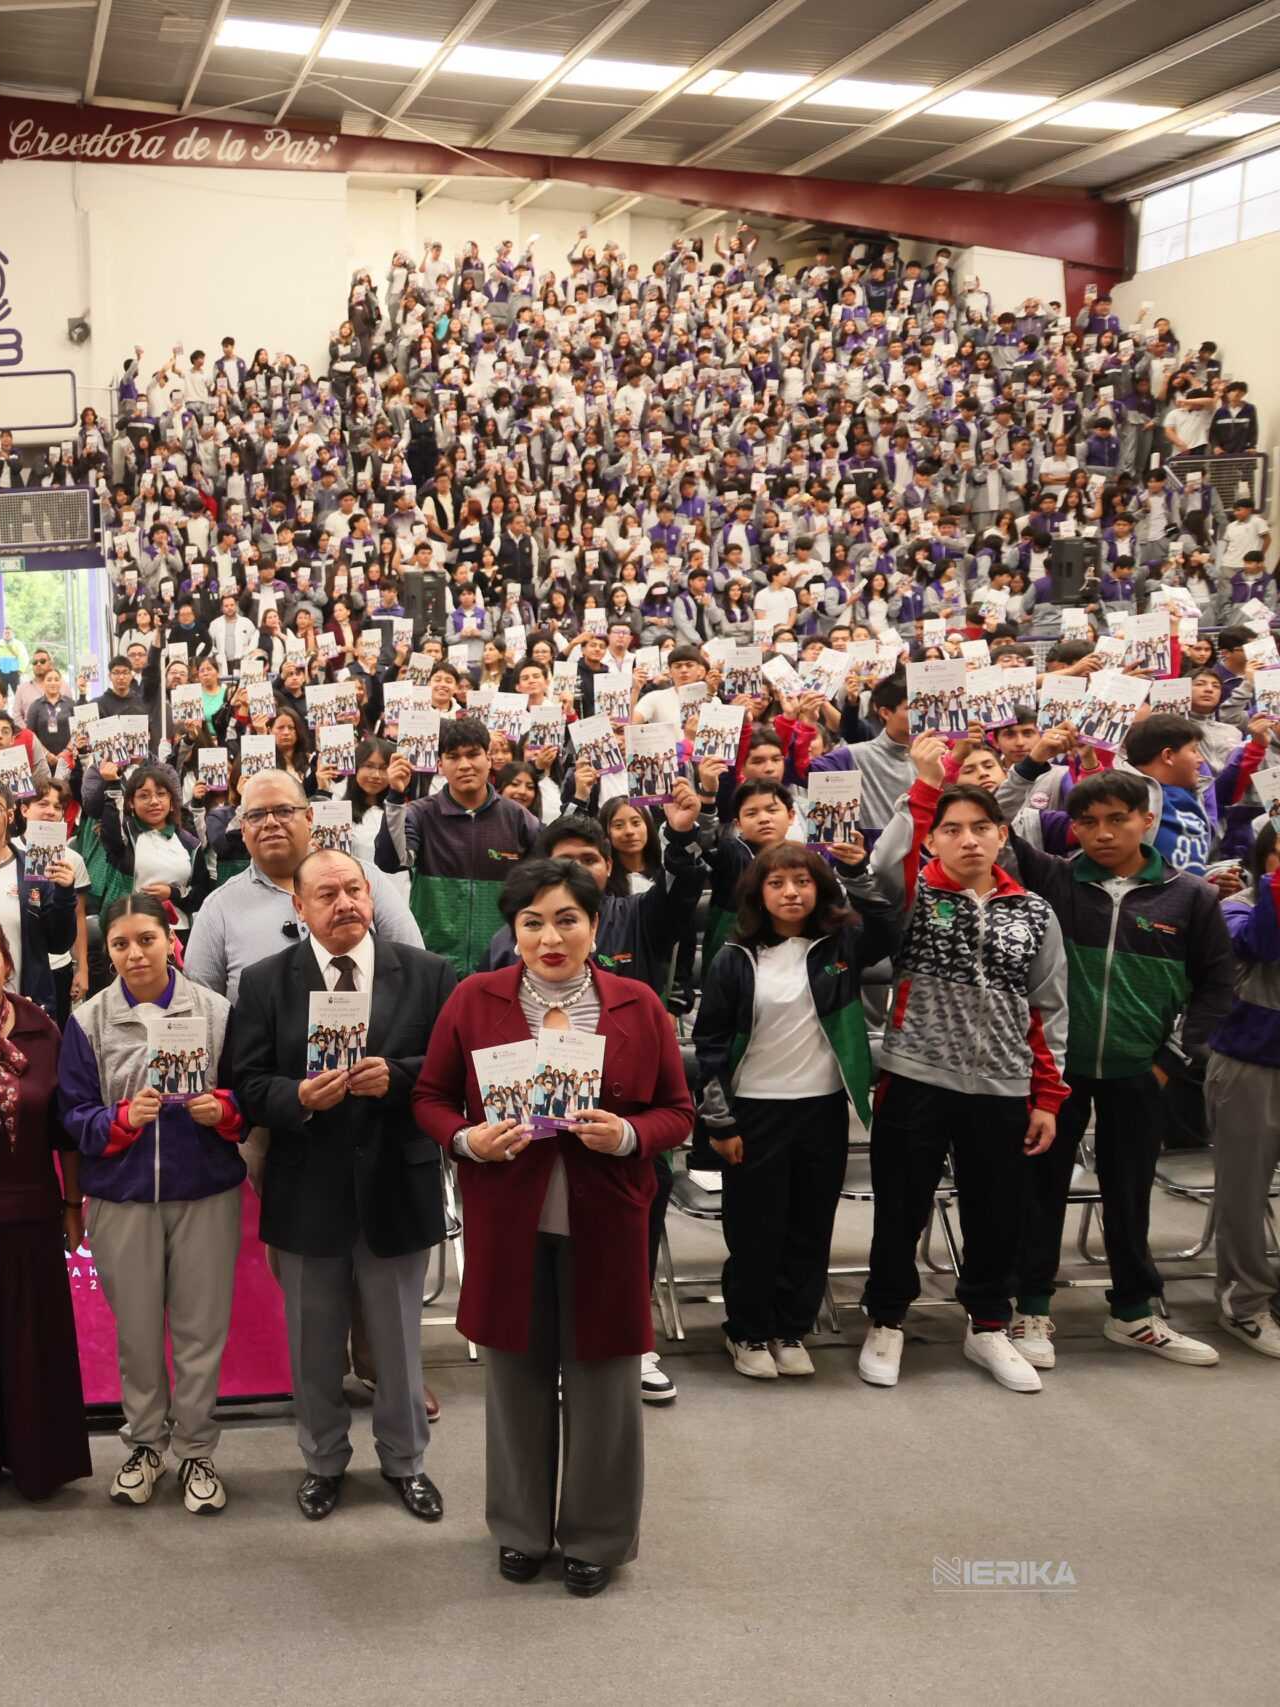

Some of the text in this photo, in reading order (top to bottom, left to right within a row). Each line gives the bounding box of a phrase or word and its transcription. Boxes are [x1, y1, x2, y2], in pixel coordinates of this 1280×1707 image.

[8, 119, 166, 161] Creadora
[172, 126, 211, 161] de
[216, 128, 246, 162] la
